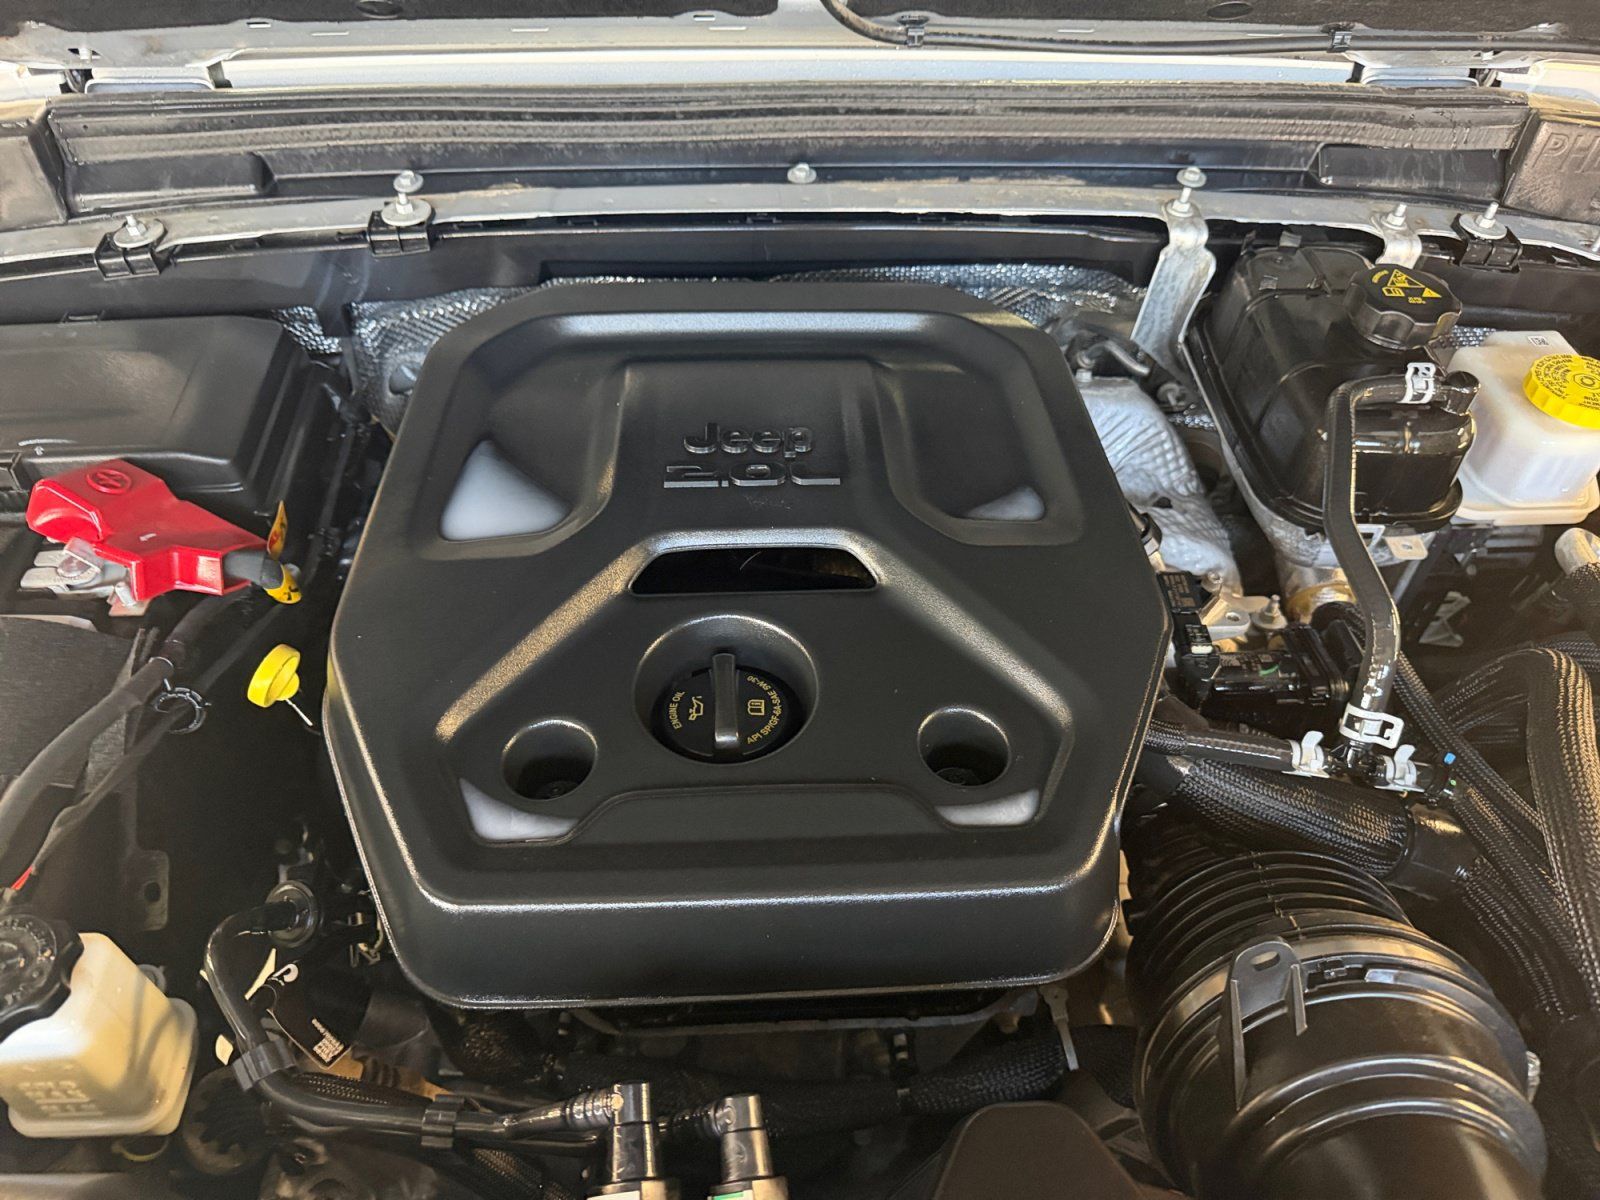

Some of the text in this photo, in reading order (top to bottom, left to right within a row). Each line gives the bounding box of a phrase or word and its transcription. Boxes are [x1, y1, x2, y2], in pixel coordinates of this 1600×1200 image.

[683, 421, 814, 459] Jeep
[663, 461, 841, 489] 2.0L
[669, 690, 686, 730] ENGINE OIL
[746, 732, 762, 745] API
